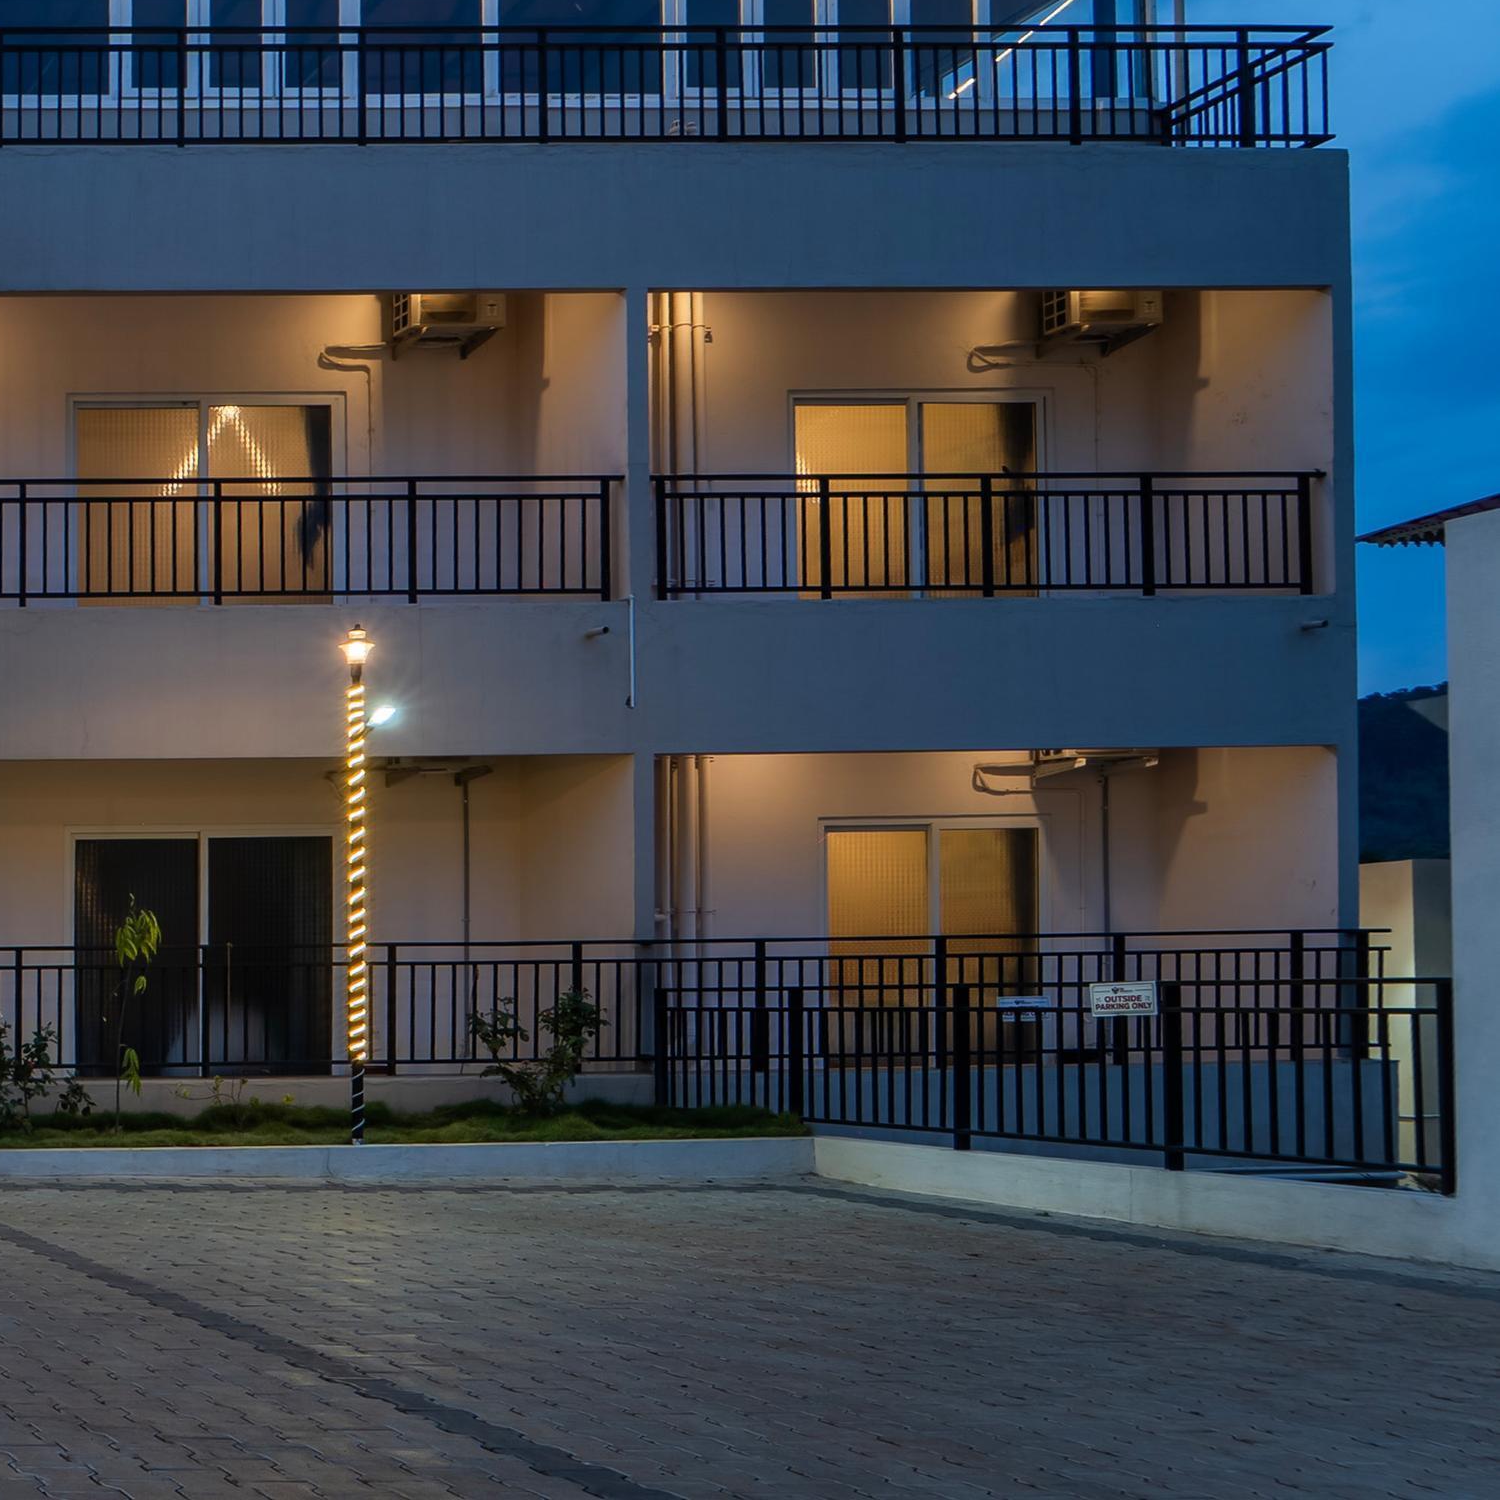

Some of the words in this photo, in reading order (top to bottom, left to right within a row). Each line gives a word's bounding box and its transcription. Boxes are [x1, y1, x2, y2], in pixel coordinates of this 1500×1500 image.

[1104, 995, 1142, 1003] OUTSIDE
[1095, 1002, 1130, 1010] PARKING
[1132, 1002, 1152, 1010] ONLY
